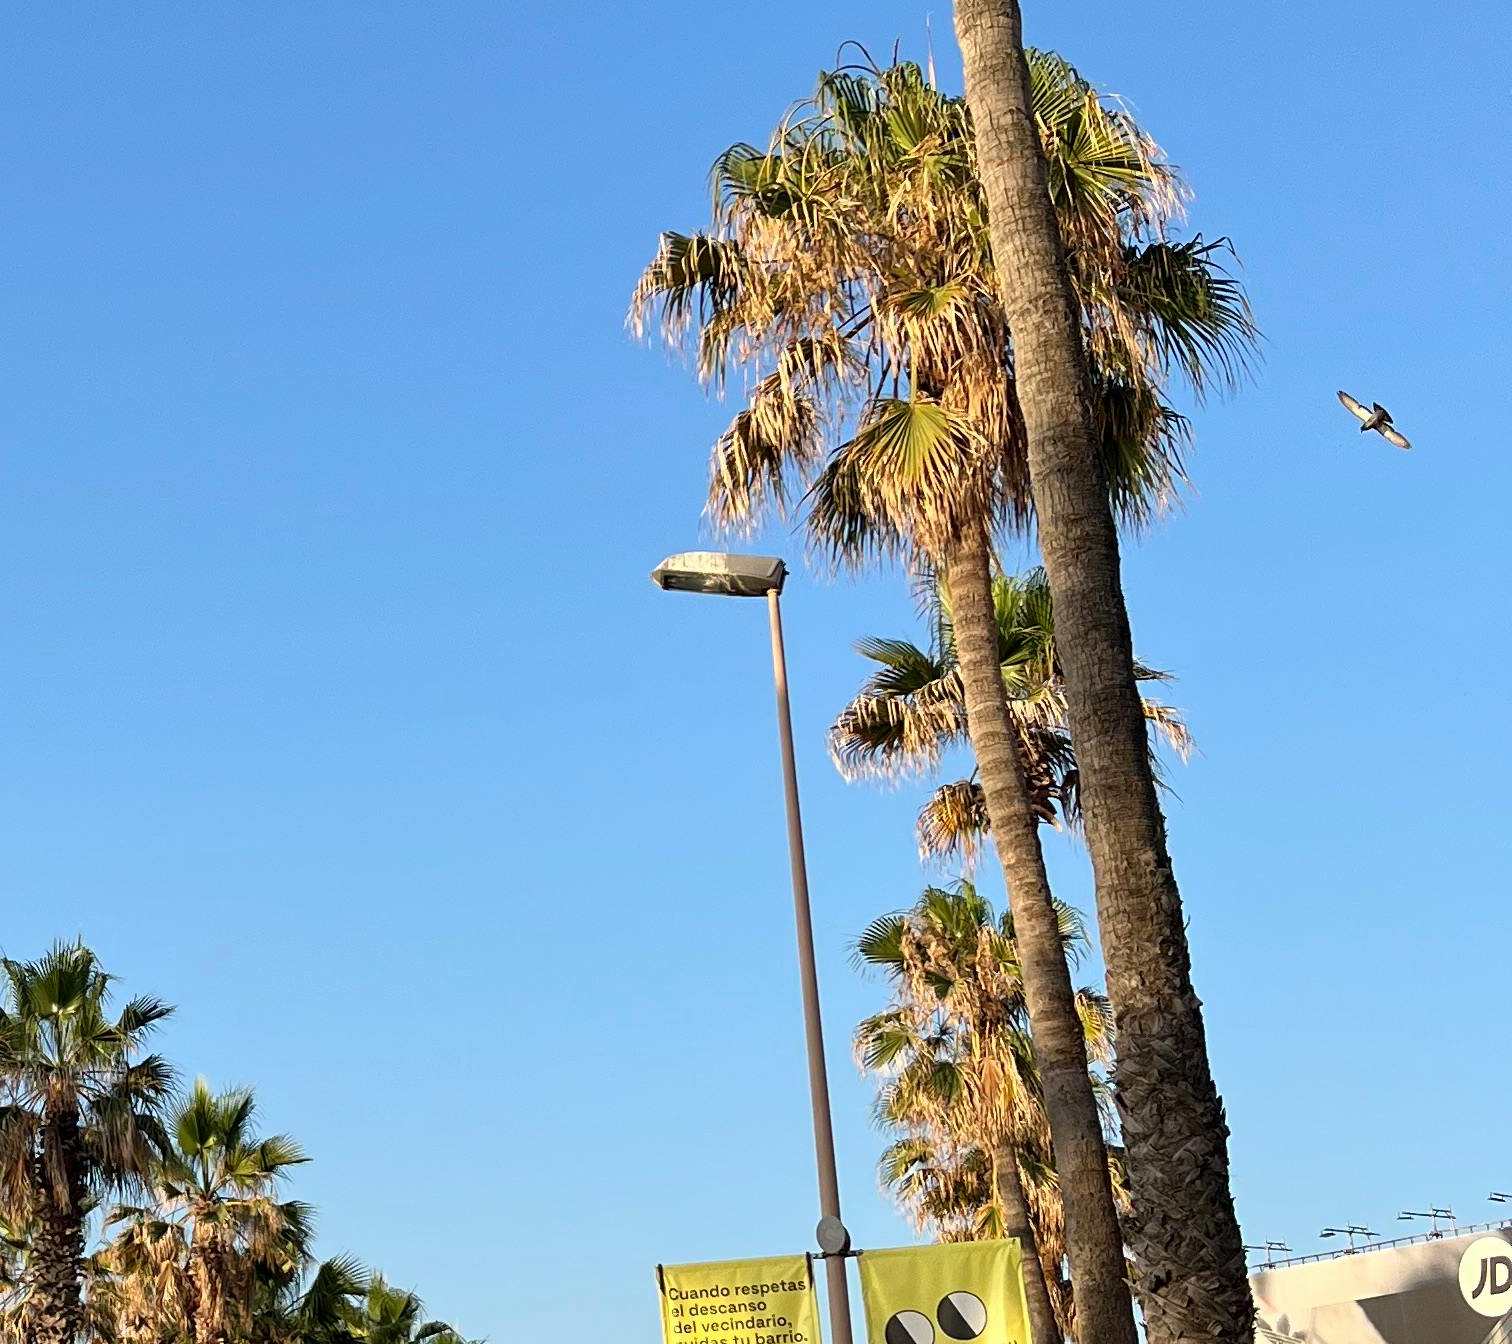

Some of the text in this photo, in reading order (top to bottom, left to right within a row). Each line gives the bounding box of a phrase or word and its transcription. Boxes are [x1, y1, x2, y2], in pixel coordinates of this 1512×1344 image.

[1472, 1255, 1512, 1299] JD
[668, 1280, 806, 1301] Cuando respetas
[672, 1301, 767, 1317] el descanso
[674, 1314, 793, 1334] del vecindario,
